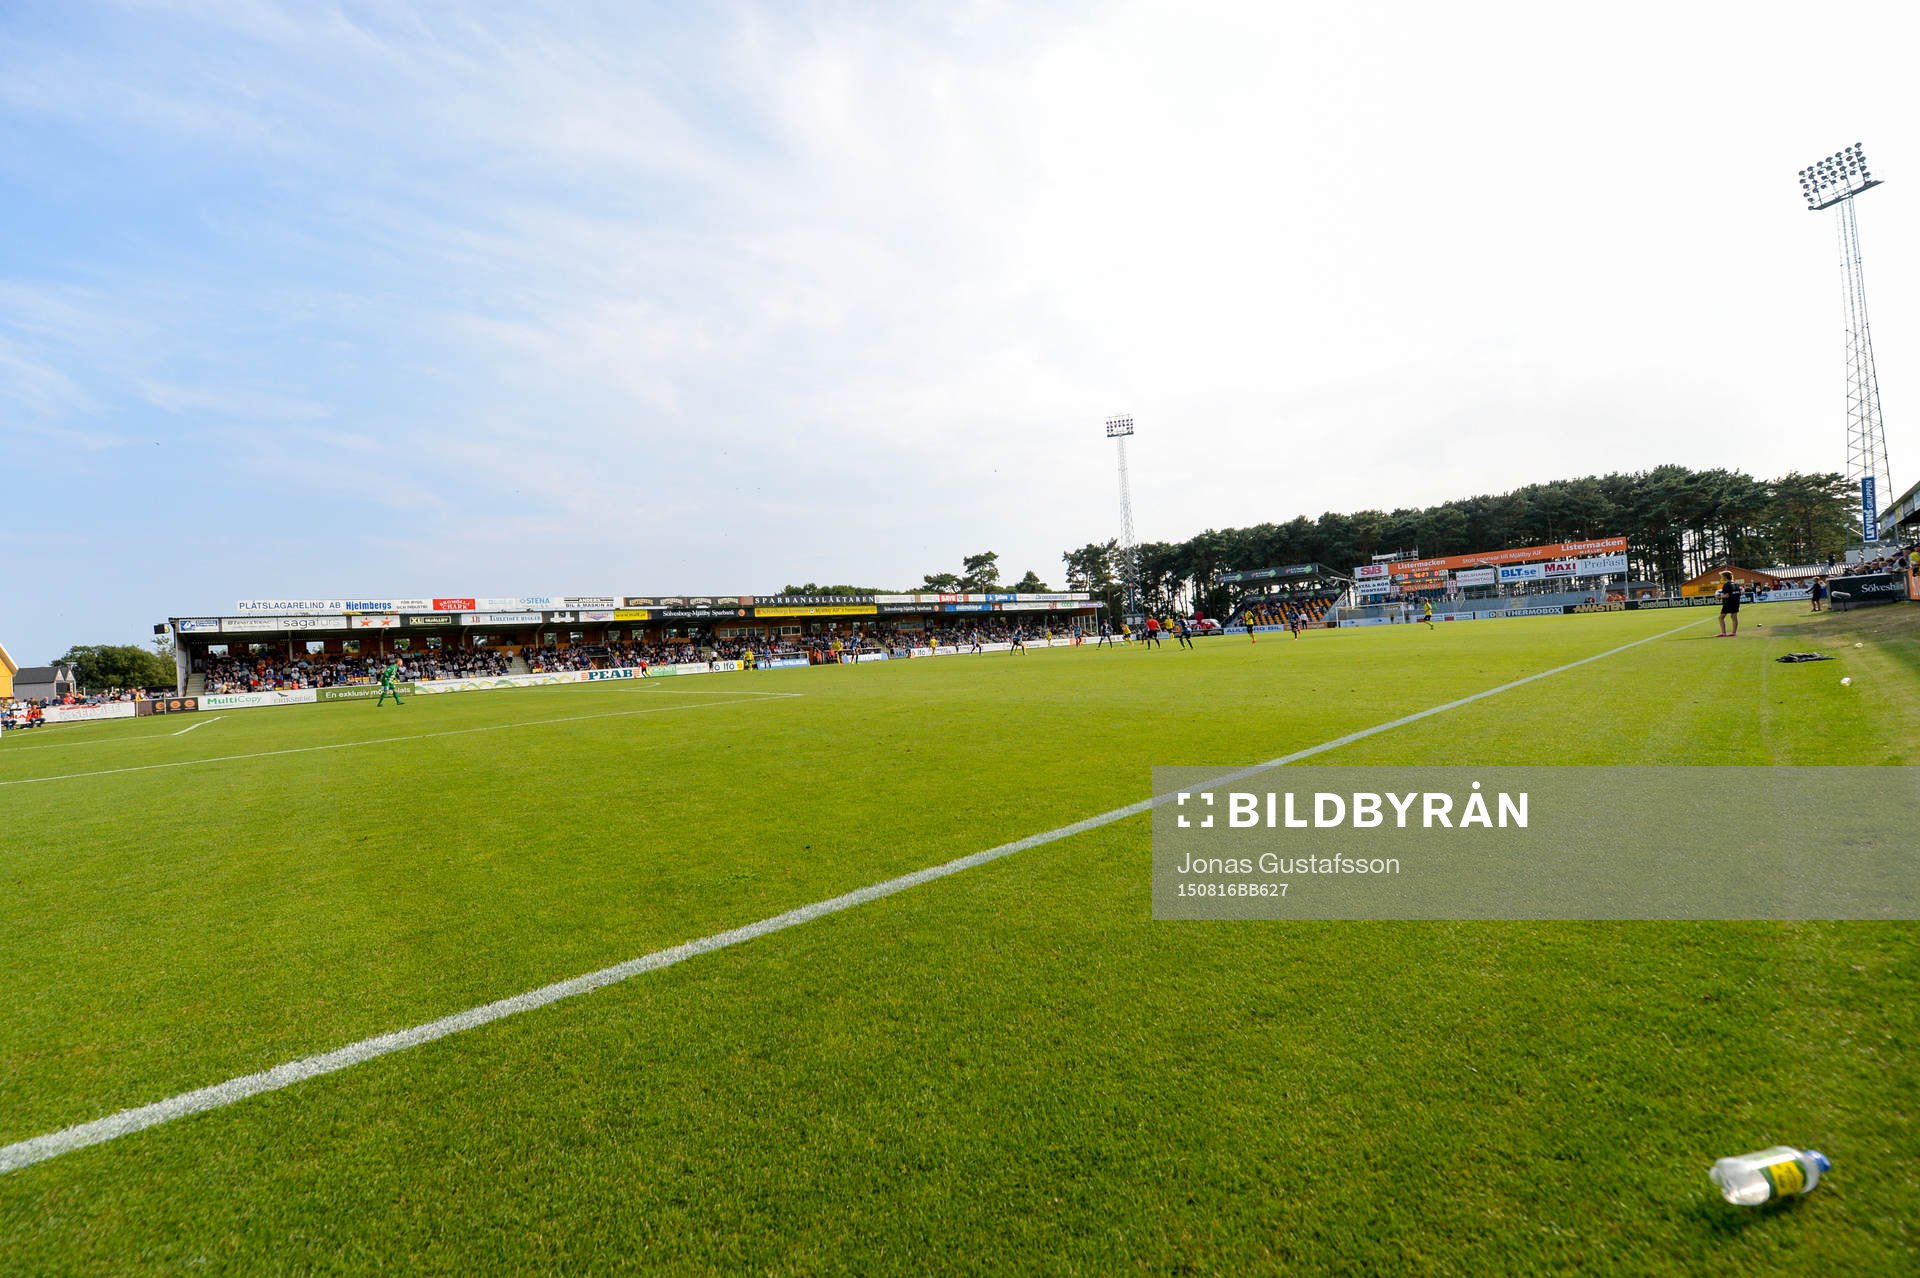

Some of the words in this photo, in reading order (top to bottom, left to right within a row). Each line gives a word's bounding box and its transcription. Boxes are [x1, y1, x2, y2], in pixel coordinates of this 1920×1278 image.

[1562, 539, 1623, 552] Listermacken
[1397, 559, 1446, 570] Listermacken
[1544, 562, 1577, 572] MAXI
[1583, 558, 1625, 569] PreFast
[1501, 568, 1537, 578] BLT.se
[239, 600, 325, 610] PLÅTSLAGARELIND
[329, 601, 341, 609] AB
[346, 601, 392, 611] Hjelmbergs
[1575, 602, 1625, 613] AMASTEN
[1638, 599, 1668, 609] Sweden
[1669, 598, 1688, 607] Rock
[1690, 596, 1723, 605] Festival
[711, 609, 735, 617] Sparbank
[1506, 607, 1561, 616] THERMOBOX
[588, 669, 633, 680] PEAB
[338, 689, 370, 699] exklusiv
[207, 695, 262, 706] MultiCopy
